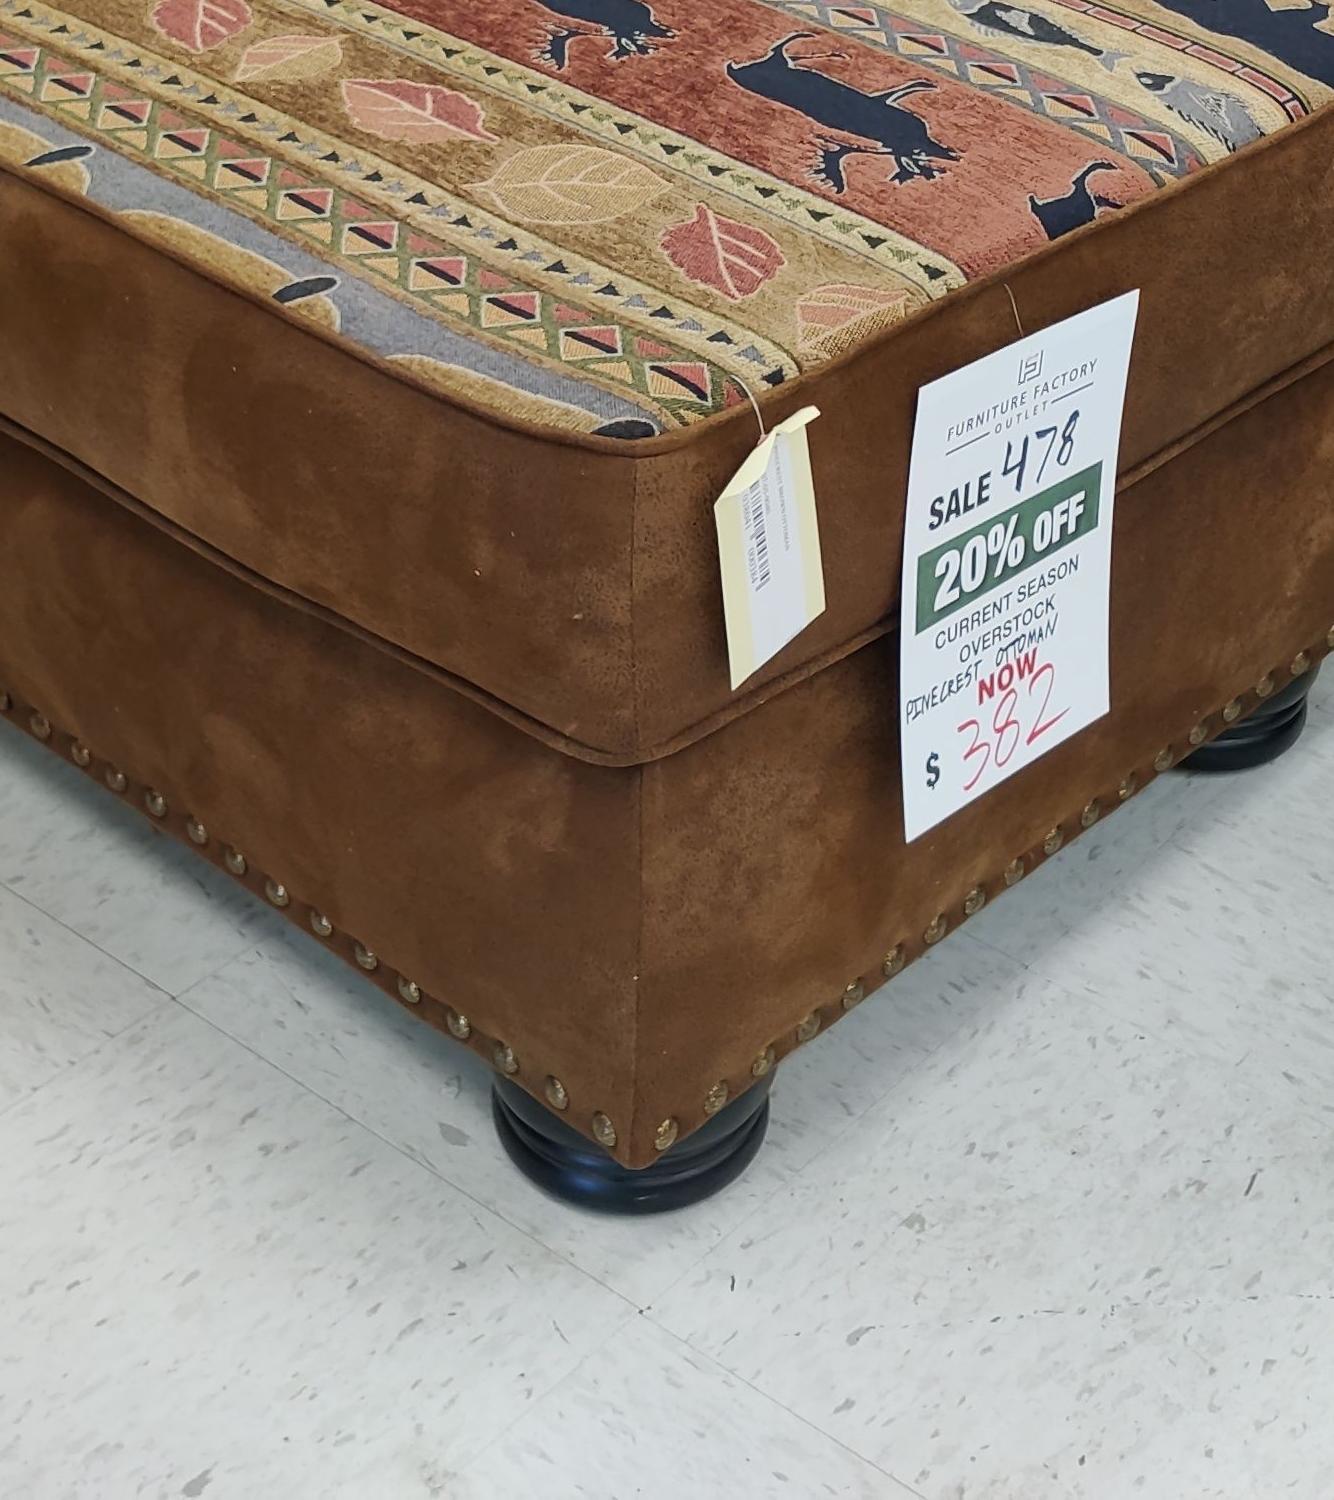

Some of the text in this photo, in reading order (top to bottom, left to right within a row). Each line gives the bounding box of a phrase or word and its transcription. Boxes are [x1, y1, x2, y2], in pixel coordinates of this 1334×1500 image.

[947, 358, 1099, 442] FURNITURE FACTORY
[994, 401, 1049, 435] OUTLET
[928, 409, 1080, 532] SALE 478
[933, 489, 1086, 612] 20% OFF
[935, 554, 1080, 650] CURRENT SEASON
[959, 594, 1057, 664] OVERSTOCK
[906, 659, 981, 725] PINECREST
[977, 647, 1038, 706] NOW
[925, 663, 1071, 792] $ 382
